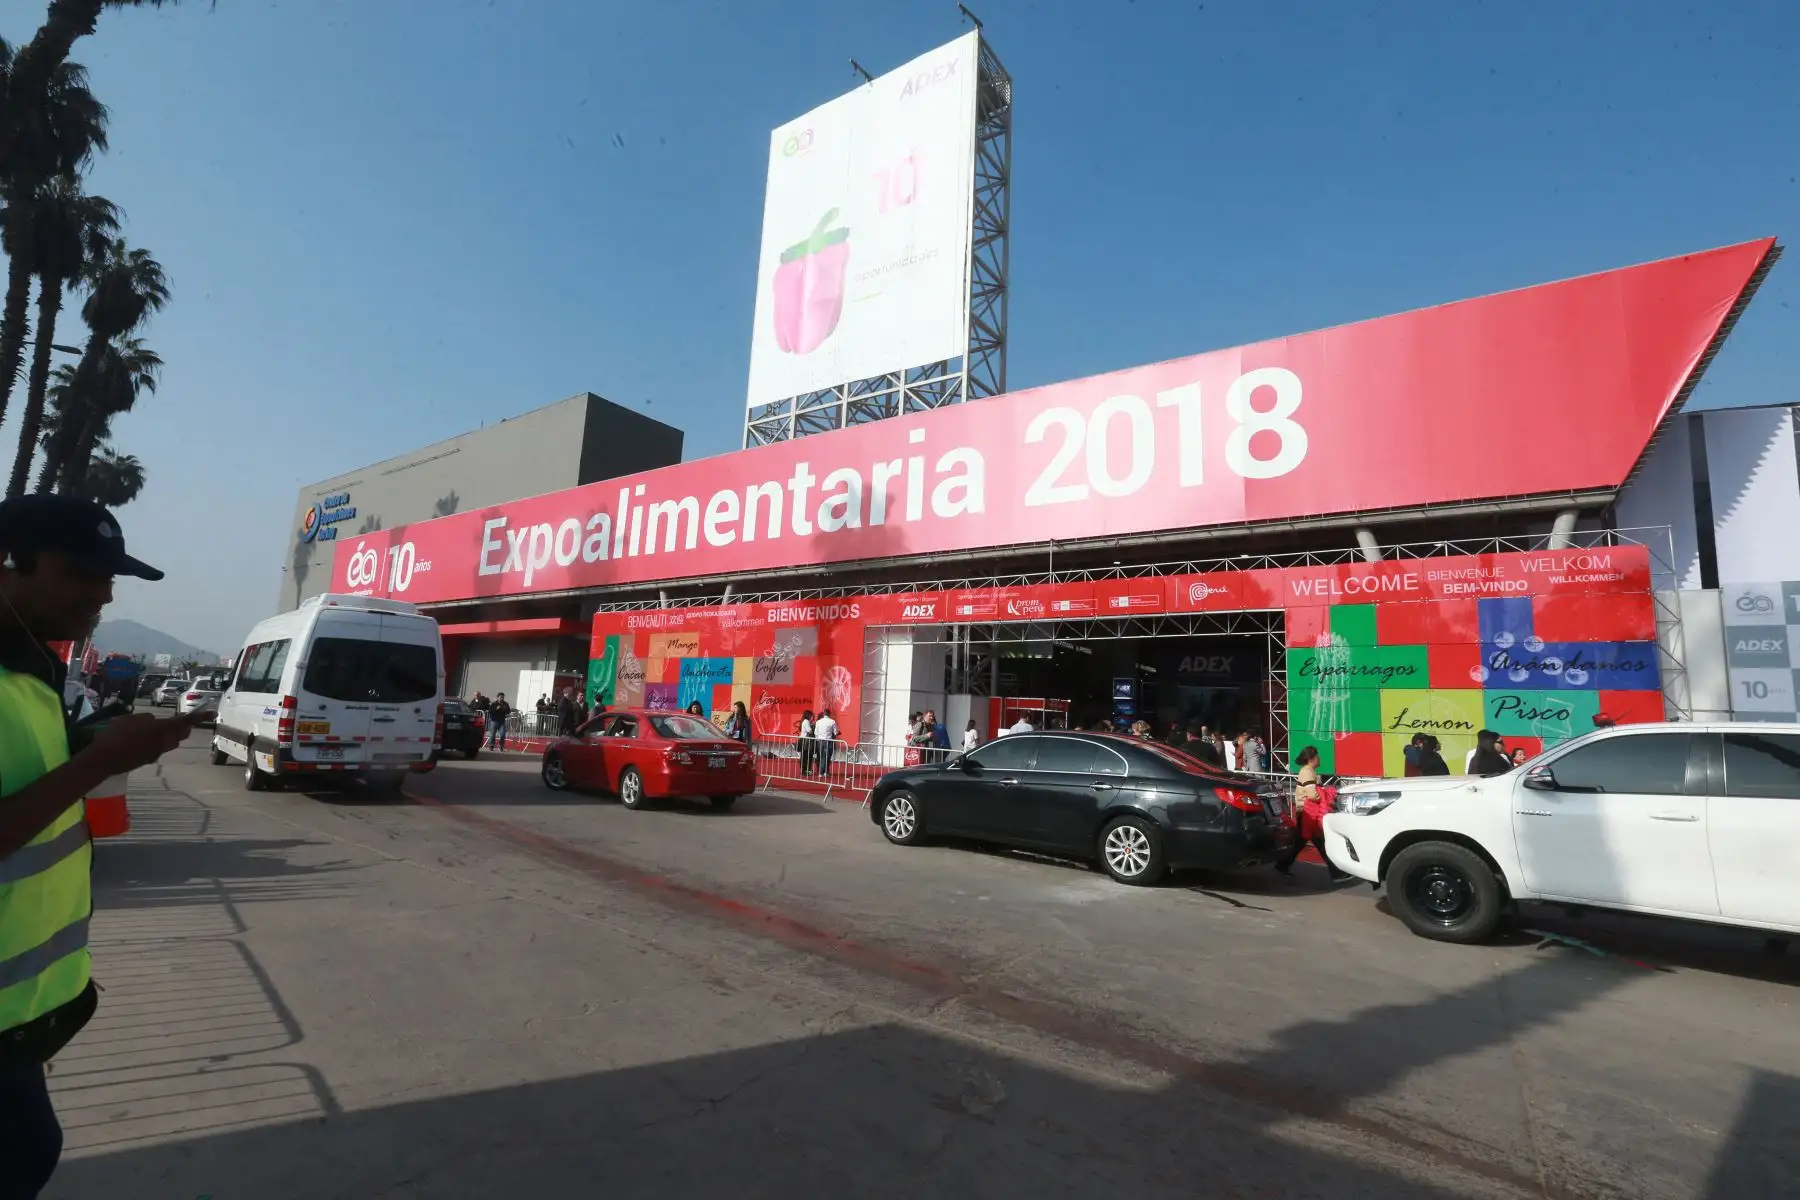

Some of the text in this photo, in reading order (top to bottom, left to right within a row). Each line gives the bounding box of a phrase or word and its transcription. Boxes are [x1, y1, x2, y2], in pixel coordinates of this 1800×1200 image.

[478, 366, 1308, 587] Expoalimentaria 2018
[388, 542, 416, 592] 10
[414, 559, 432, 573] años
[1519, 554, 1612, 574] WELKOM
[1427, 566, 1506, 582] BIENVENUE
[1548, 572, 1625, 585] WILLKOMMEN
[1291, 572, 1420, 597] WELCOME
[1443, 579, 1529, 595] BEM-VINDO
[767, 604, 861, 624] BIENVENIDOS
[902, 604, 936, 617] ADEX
[627, 613, 668, 629] BENVENUTI
[667, 638, 698, 654] Mango
[1735, 639, 1784, 651] ADEX
[755, 657, 790, 681] Coffee
[1178, 656, 1234, 672] ADEX
[1490, 649, 1650, 673] Arándanos
[618, 666, 647, 680] Cacao
[1741, 680, 1768, 699] 10
[1490, 695, 1572, 721] Pisco
[1390, 707, 1475, 731] Lemon
